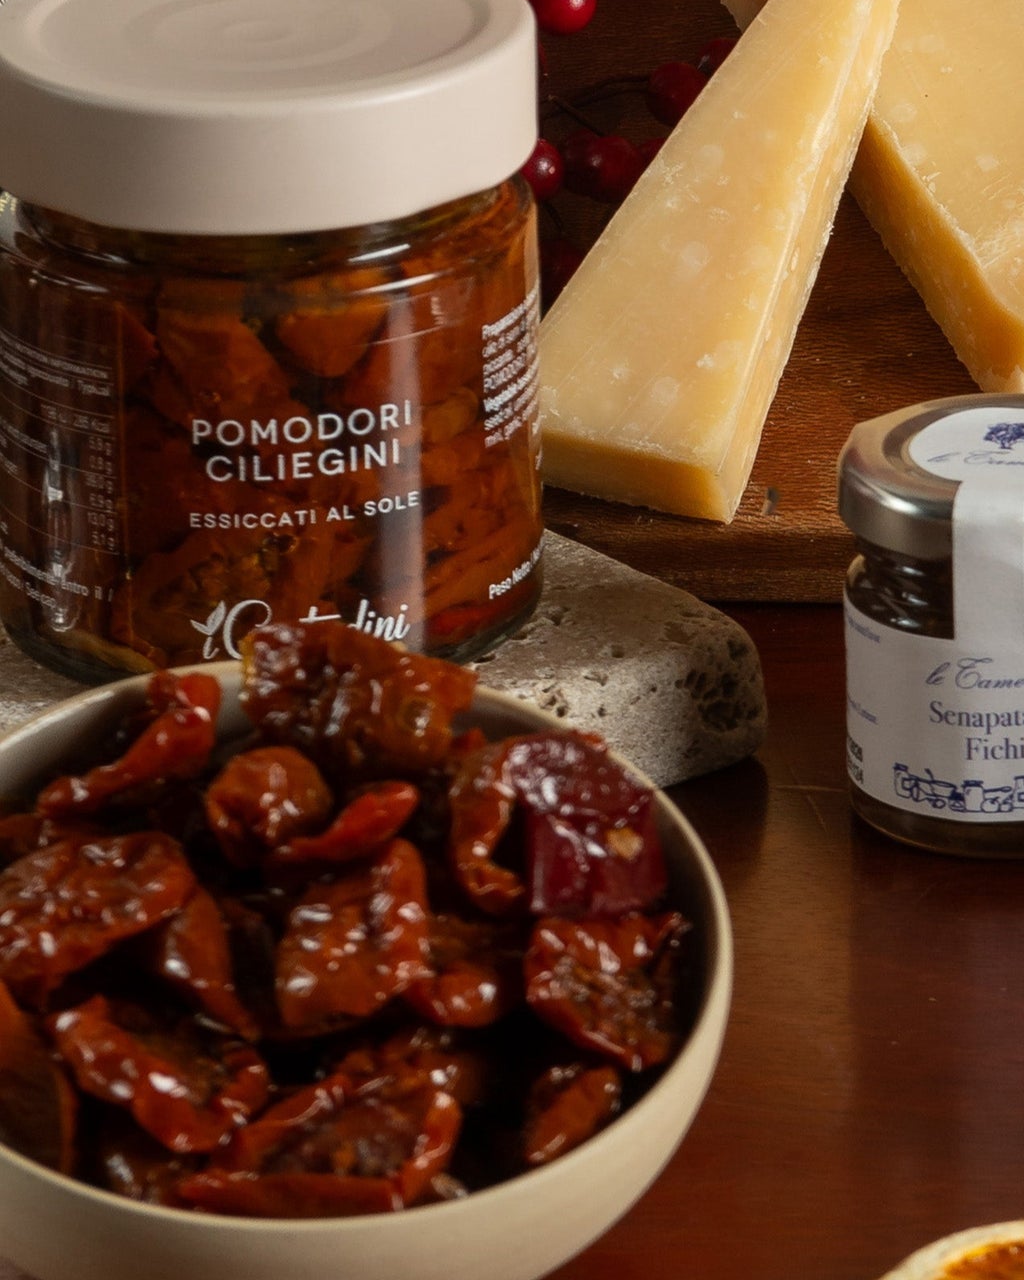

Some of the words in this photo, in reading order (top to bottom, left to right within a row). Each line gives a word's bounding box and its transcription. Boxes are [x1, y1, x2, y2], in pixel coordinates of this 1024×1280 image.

[192, 399, 412, 446] POMODORI
[206, 438, 399, 482] CILIEGINI
[190, 509, 316, 529] ESSICCATI
[326, 504, 355, 522] AL
[364, 490, 420, 516] SOLE
[925, 662, 951, 686] le
